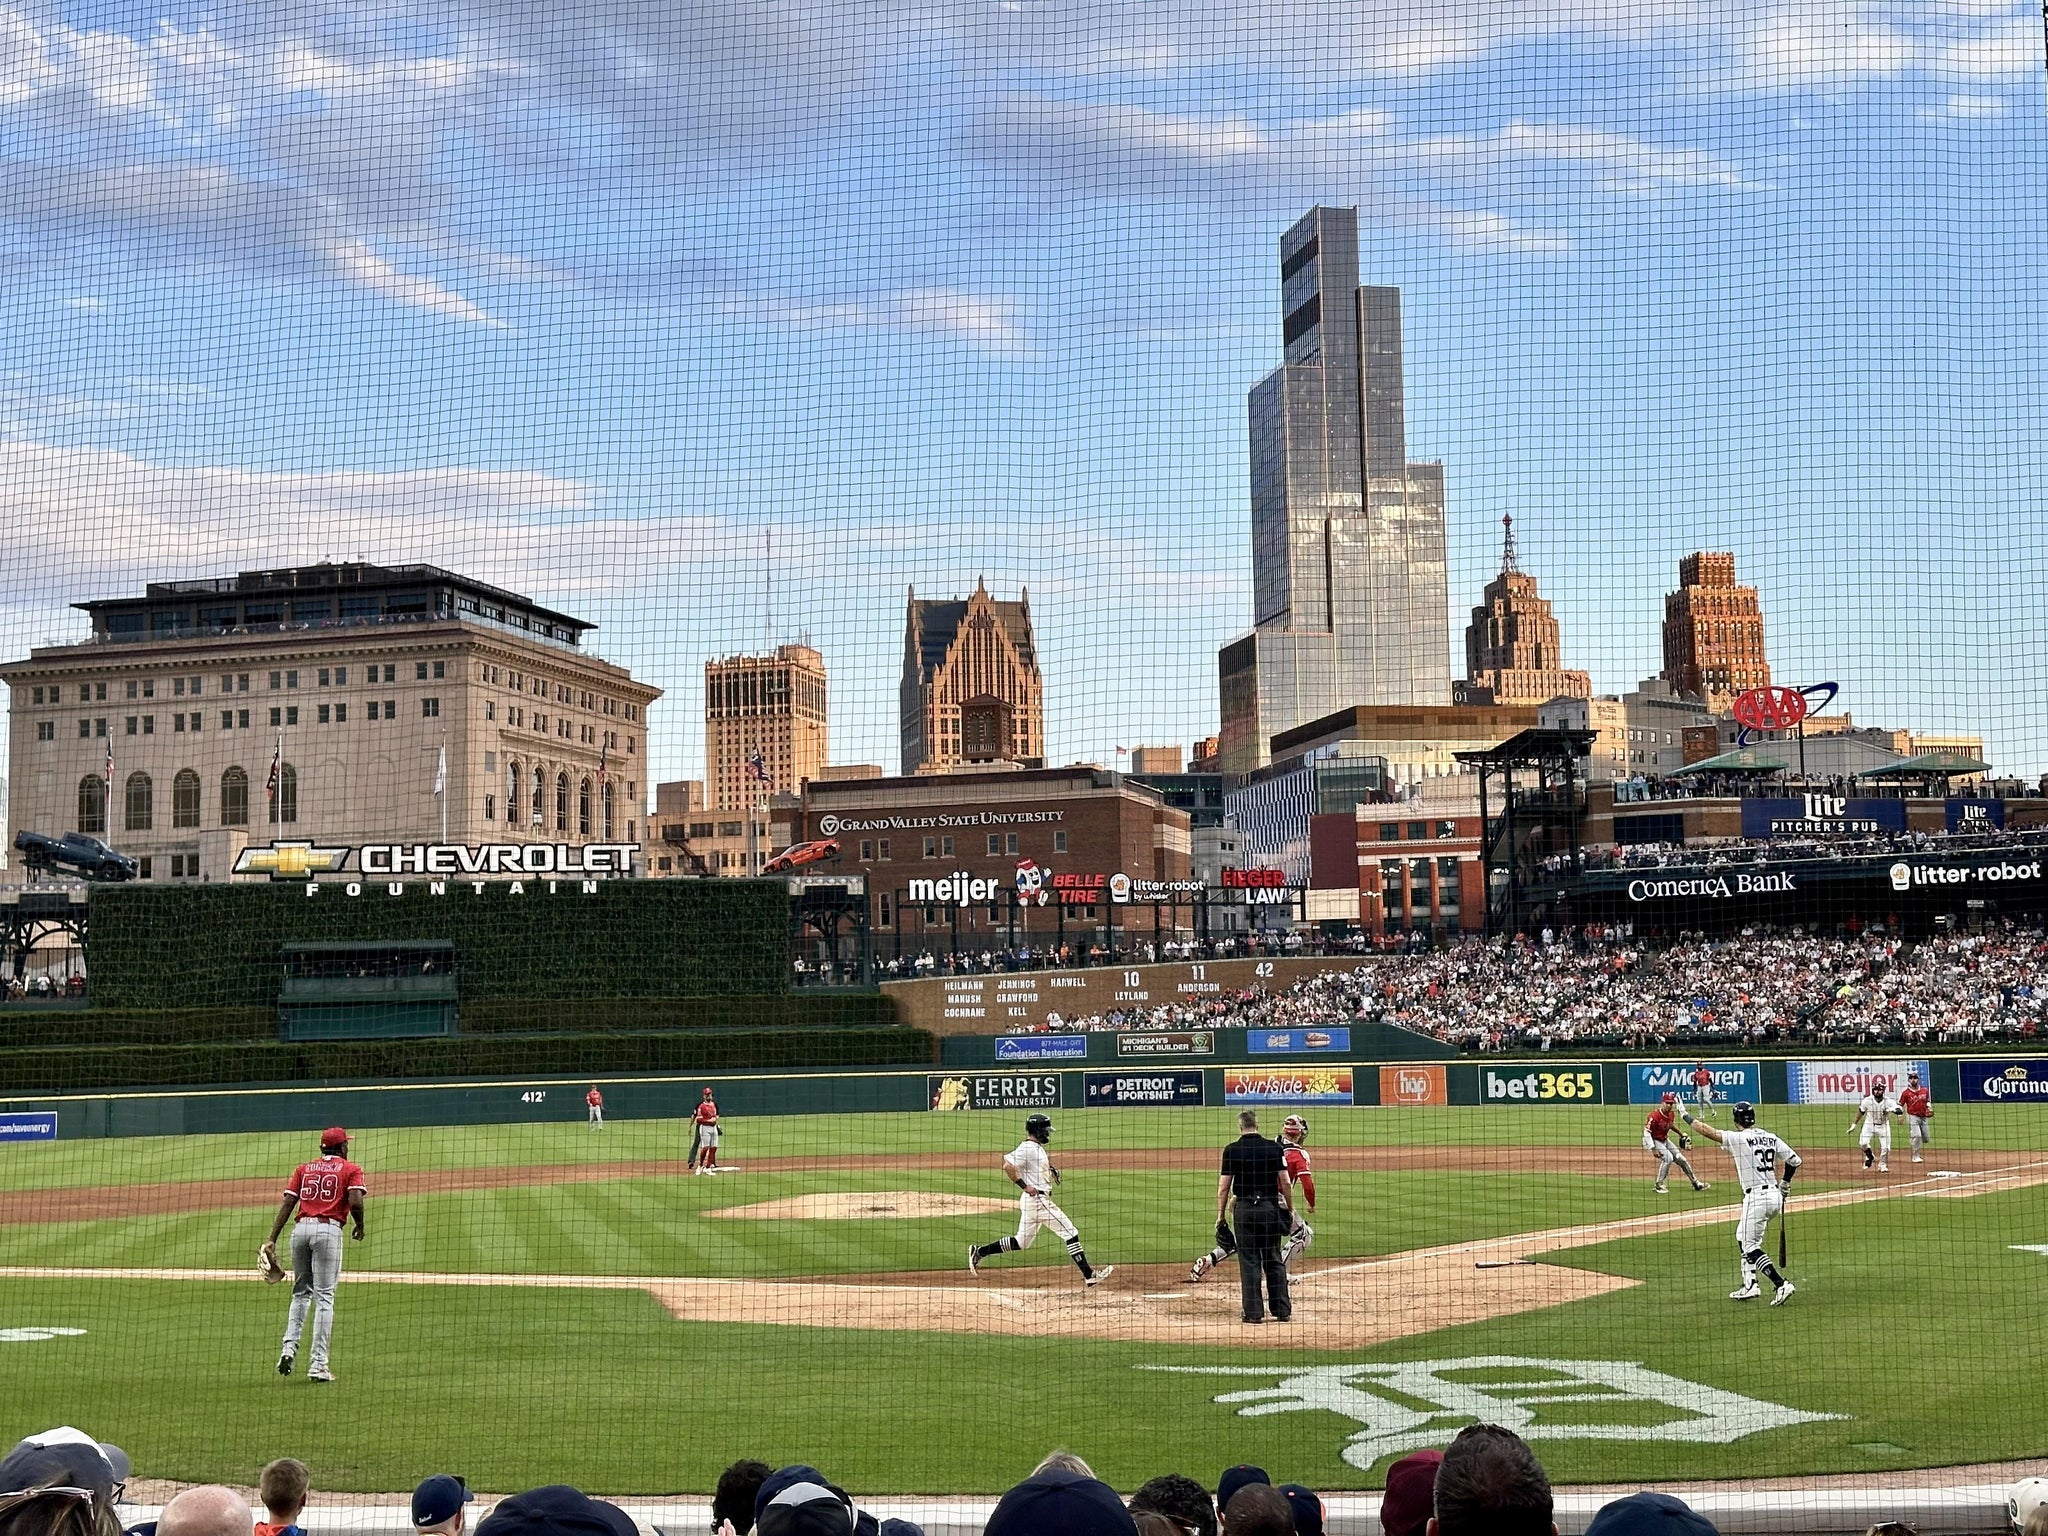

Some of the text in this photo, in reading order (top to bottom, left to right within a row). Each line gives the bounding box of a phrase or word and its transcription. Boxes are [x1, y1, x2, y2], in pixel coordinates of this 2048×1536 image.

[1738, 688, 1801, 729] AAA
[1803, 792, 1846, 821] Lite
[1963, 805, 1987, 820] Lite
[840, 811, 1064, 831] GRAND VALLEY STATE UNIVERSITY
[1771, 821, 1845, 832] PITCHER'S
[361, 844, 640, 873] CHEVROLET
[1053, 874, 1105, 887] BELLE
[1222, 870, 1285, 887] FIEGER
[1736, 871, 1797, 893] Bank
[306, 881, 597, 896] FOUNTAIN
[909, 871, 999, 908] meijer
[1059, 889, 1098, 903] TIRE
[1245, 888, 1285, 904] LAW
[1133, 892, 1169, 901] by whisker
[1191, 965, 1205, 980] 11
[1255, 962, 1274, 977] 42
[944, 981, 984, 991] HEILMANN
[998, 979, 1036, 990] JENNINGS
[1050, 977, 1086, 988] HARWELL
[1123, 971, 1140, 987] 10
[1177, 983, 1220, 992] ANDERSON
[947, 994, 981, 1004] MANUSH
[996, 993, 1038, 1003] CRAWFORD
[1115, 991, 1149, 1001] LEYLAND
[944, 1008, 985, 1018] COCHRANE
[1008, 1007, 1027, 1016] KELL
[1122, 1037, 1169, 1045] MICHIGAN'S
[1156, 1043, 1189, 1051] BUILDER
[998, 1047, 1083, 1059] Foundation Restoration
[975, 1077, 1056, 1097] FERRIS
[1116, 1078, 1175, 1091] DETROIT
[1234, 1074, 1303, 1097] Surfside
[1487, 1072, 1594, 1098] bet365
[1817, 1066, 1898, 1097] meijer
[1983, 1077, 2048, 1099] Corona
[975, 1097, 1055, 1107] STATE UNIVERSITY
[1117, 1090, 1175, 1100] SPORTSNET
[1754, 1148, 1775, 1172] 39
[300, 1173, 339, 1201] 59
